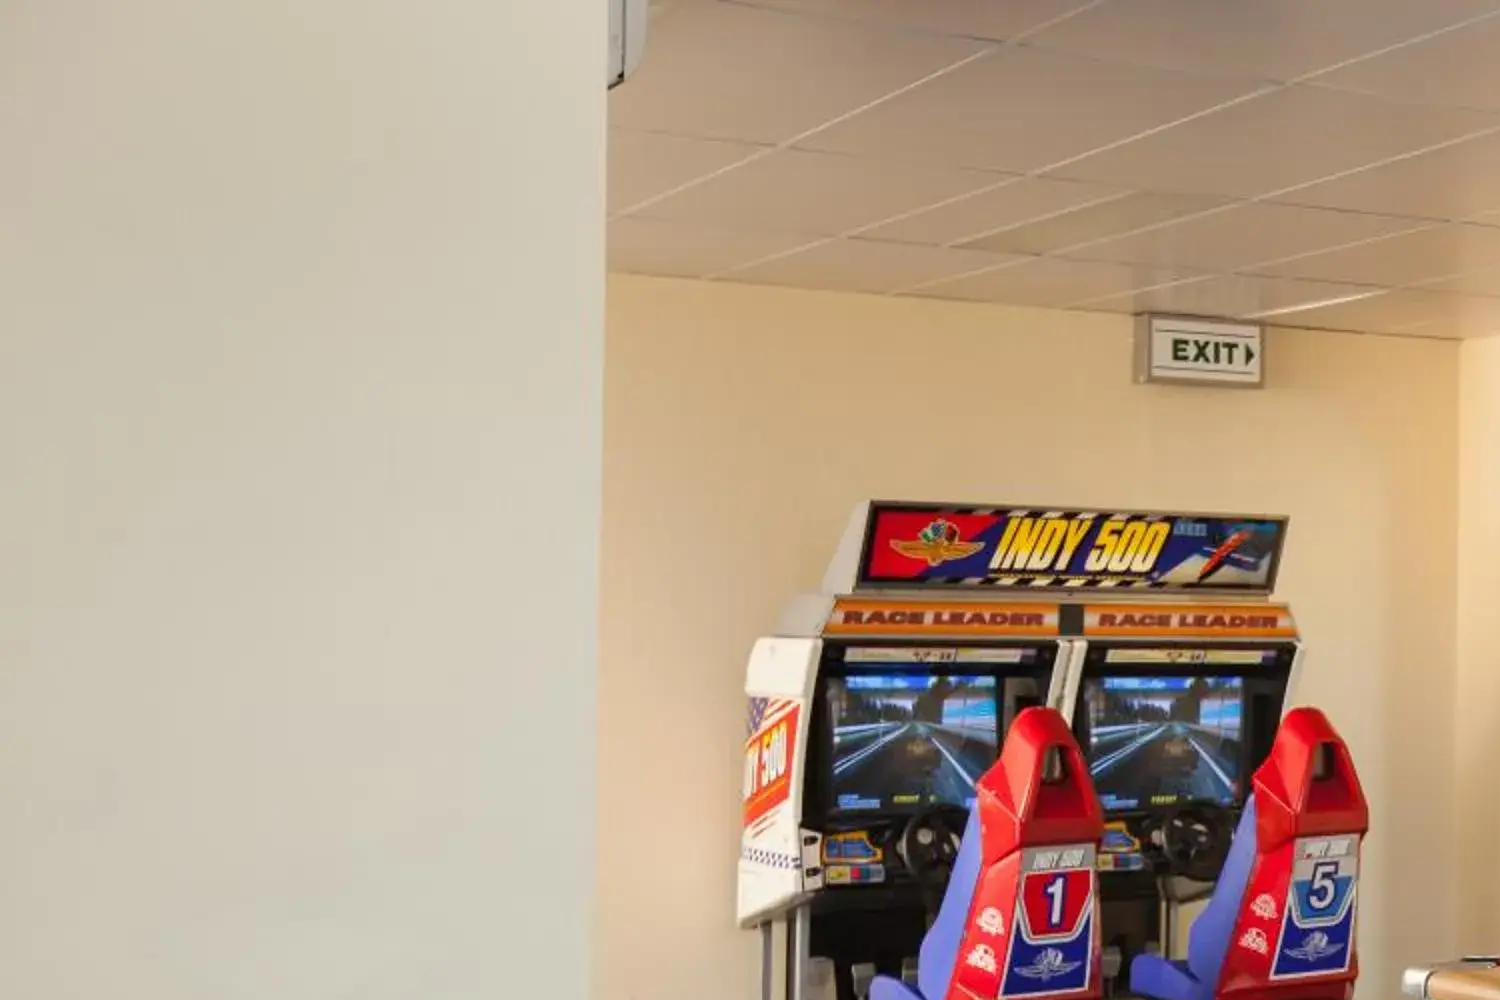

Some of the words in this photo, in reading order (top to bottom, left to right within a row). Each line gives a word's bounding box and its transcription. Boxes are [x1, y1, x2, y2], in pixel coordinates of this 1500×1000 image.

[1171, 338, 1239, 365] EXIT
[988, 514, 1088, 573] INDY
[1083, 518, 1172, 575] 500
[842, 609, 926, 626] RACE
[930, 610, 1045, 627] LEADER
[1097, 613, 1173, 629] RACE
[1177, 613, 1279, 629] LEADER
[1046, 876, 1065, 927] 1
[1309, 863, 1338, 910] 5
